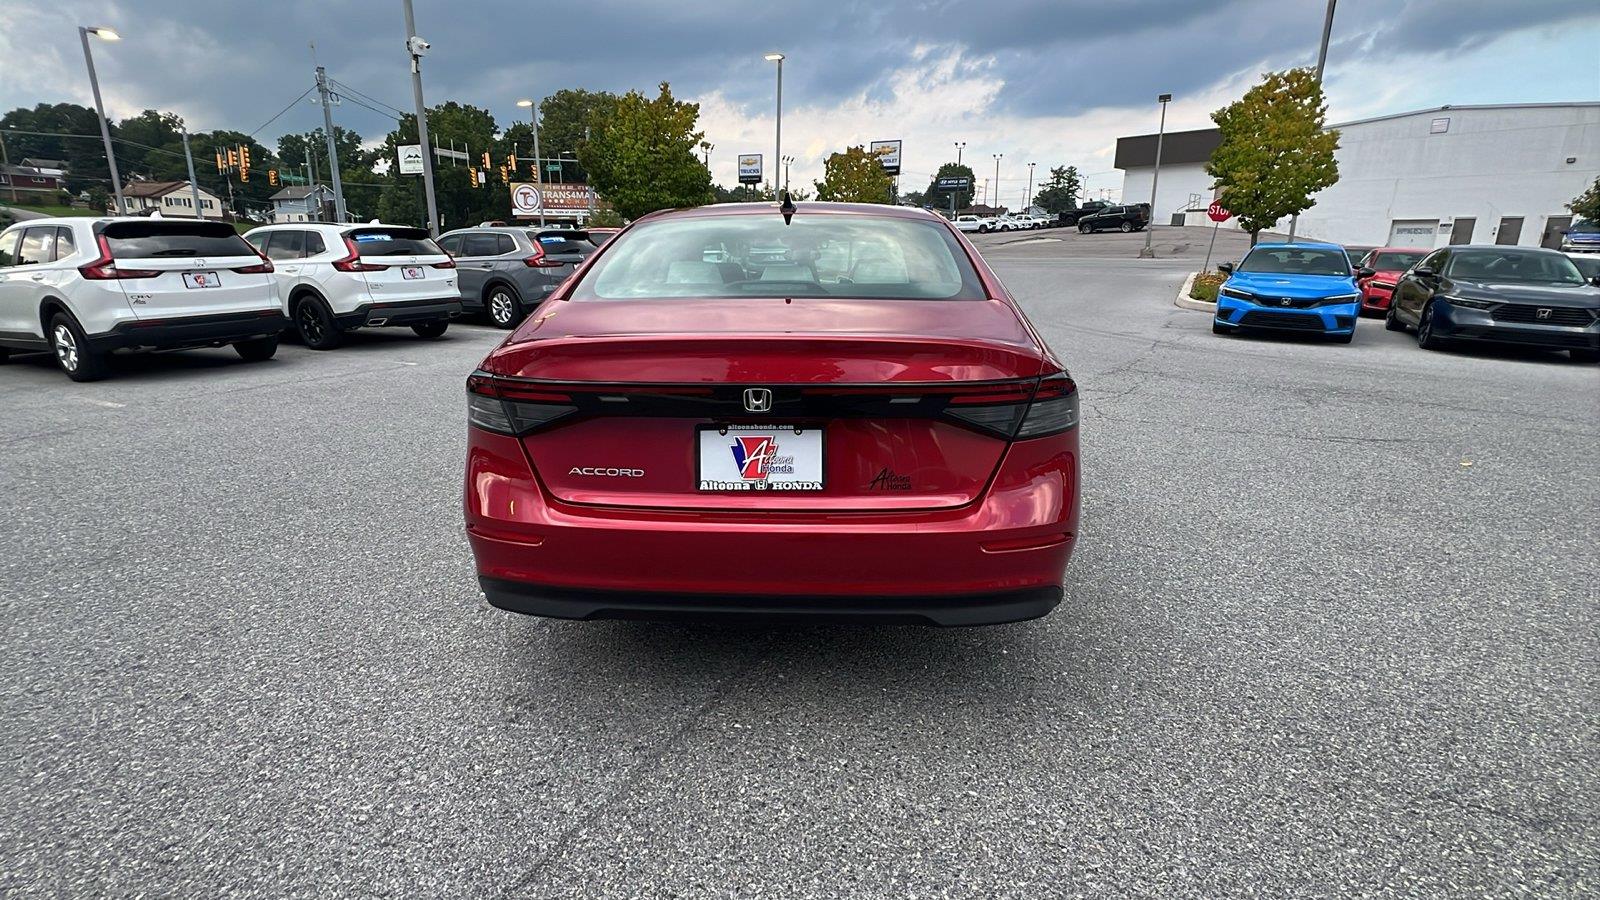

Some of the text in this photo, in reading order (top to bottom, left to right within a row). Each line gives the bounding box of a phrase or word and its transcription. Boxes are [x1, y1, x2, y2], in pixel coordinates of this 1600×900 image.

[568, 467, 645, 477] ACCORD
[761, 464, 794, 473] Honda
[699, 481, 824, 490] Altoona HONDA
